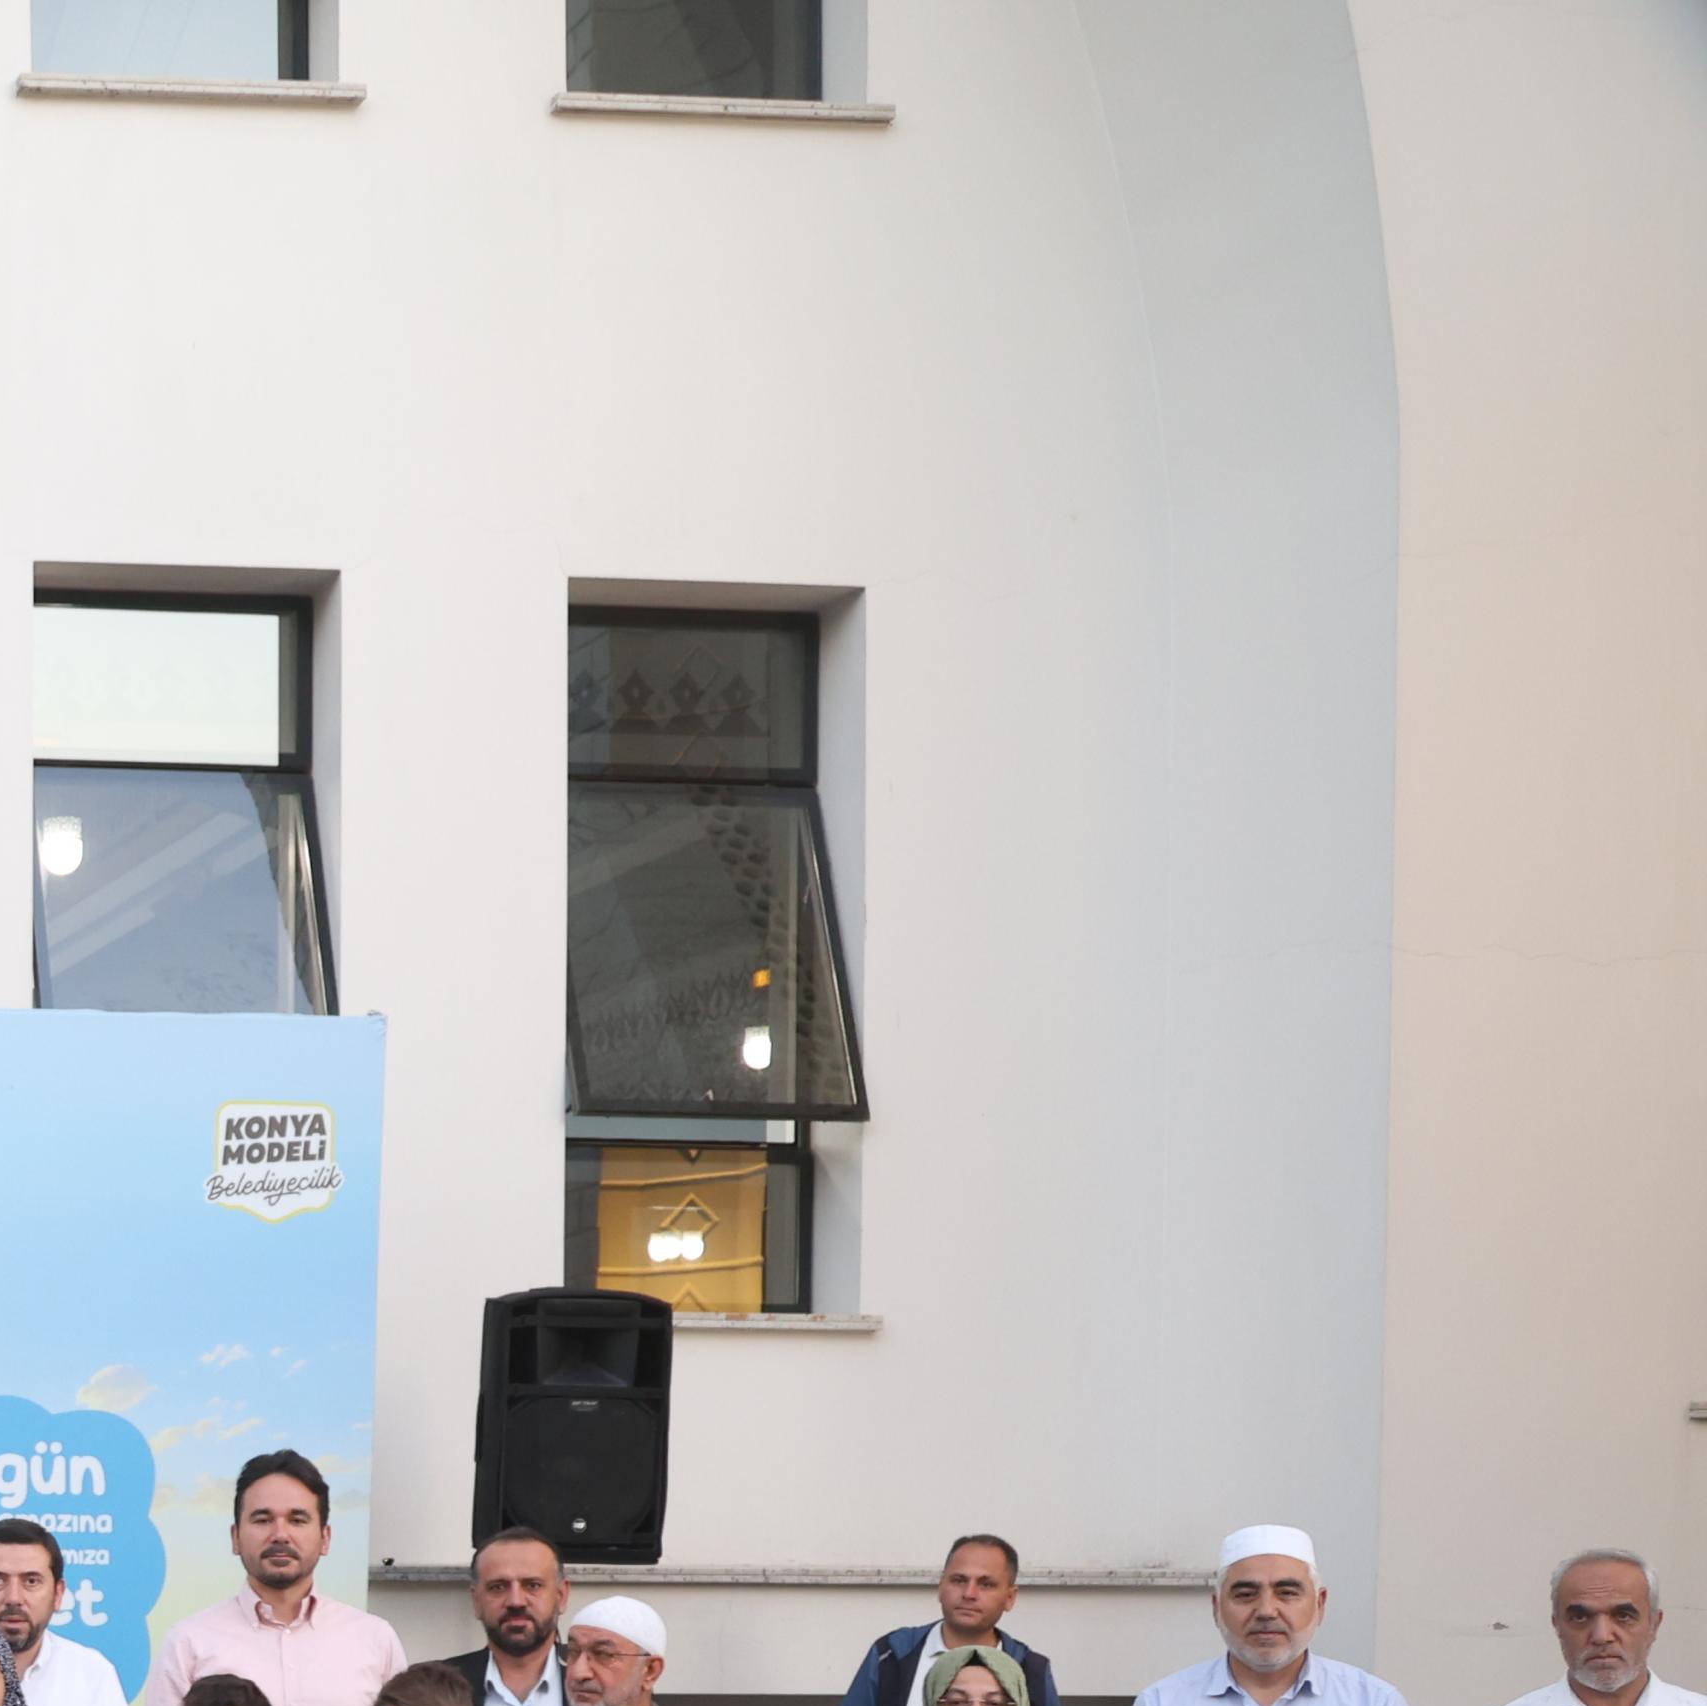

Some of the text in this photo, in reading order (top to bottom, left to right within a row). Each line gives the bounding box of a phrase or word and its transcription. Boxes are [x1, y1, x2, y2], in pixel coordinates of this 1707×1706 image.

[224, 1114, 327, 1141] KONYA
[222, 1140, 326, 1166] MODELİ
[206, 1165, 343, 1207] Belediyecilik
